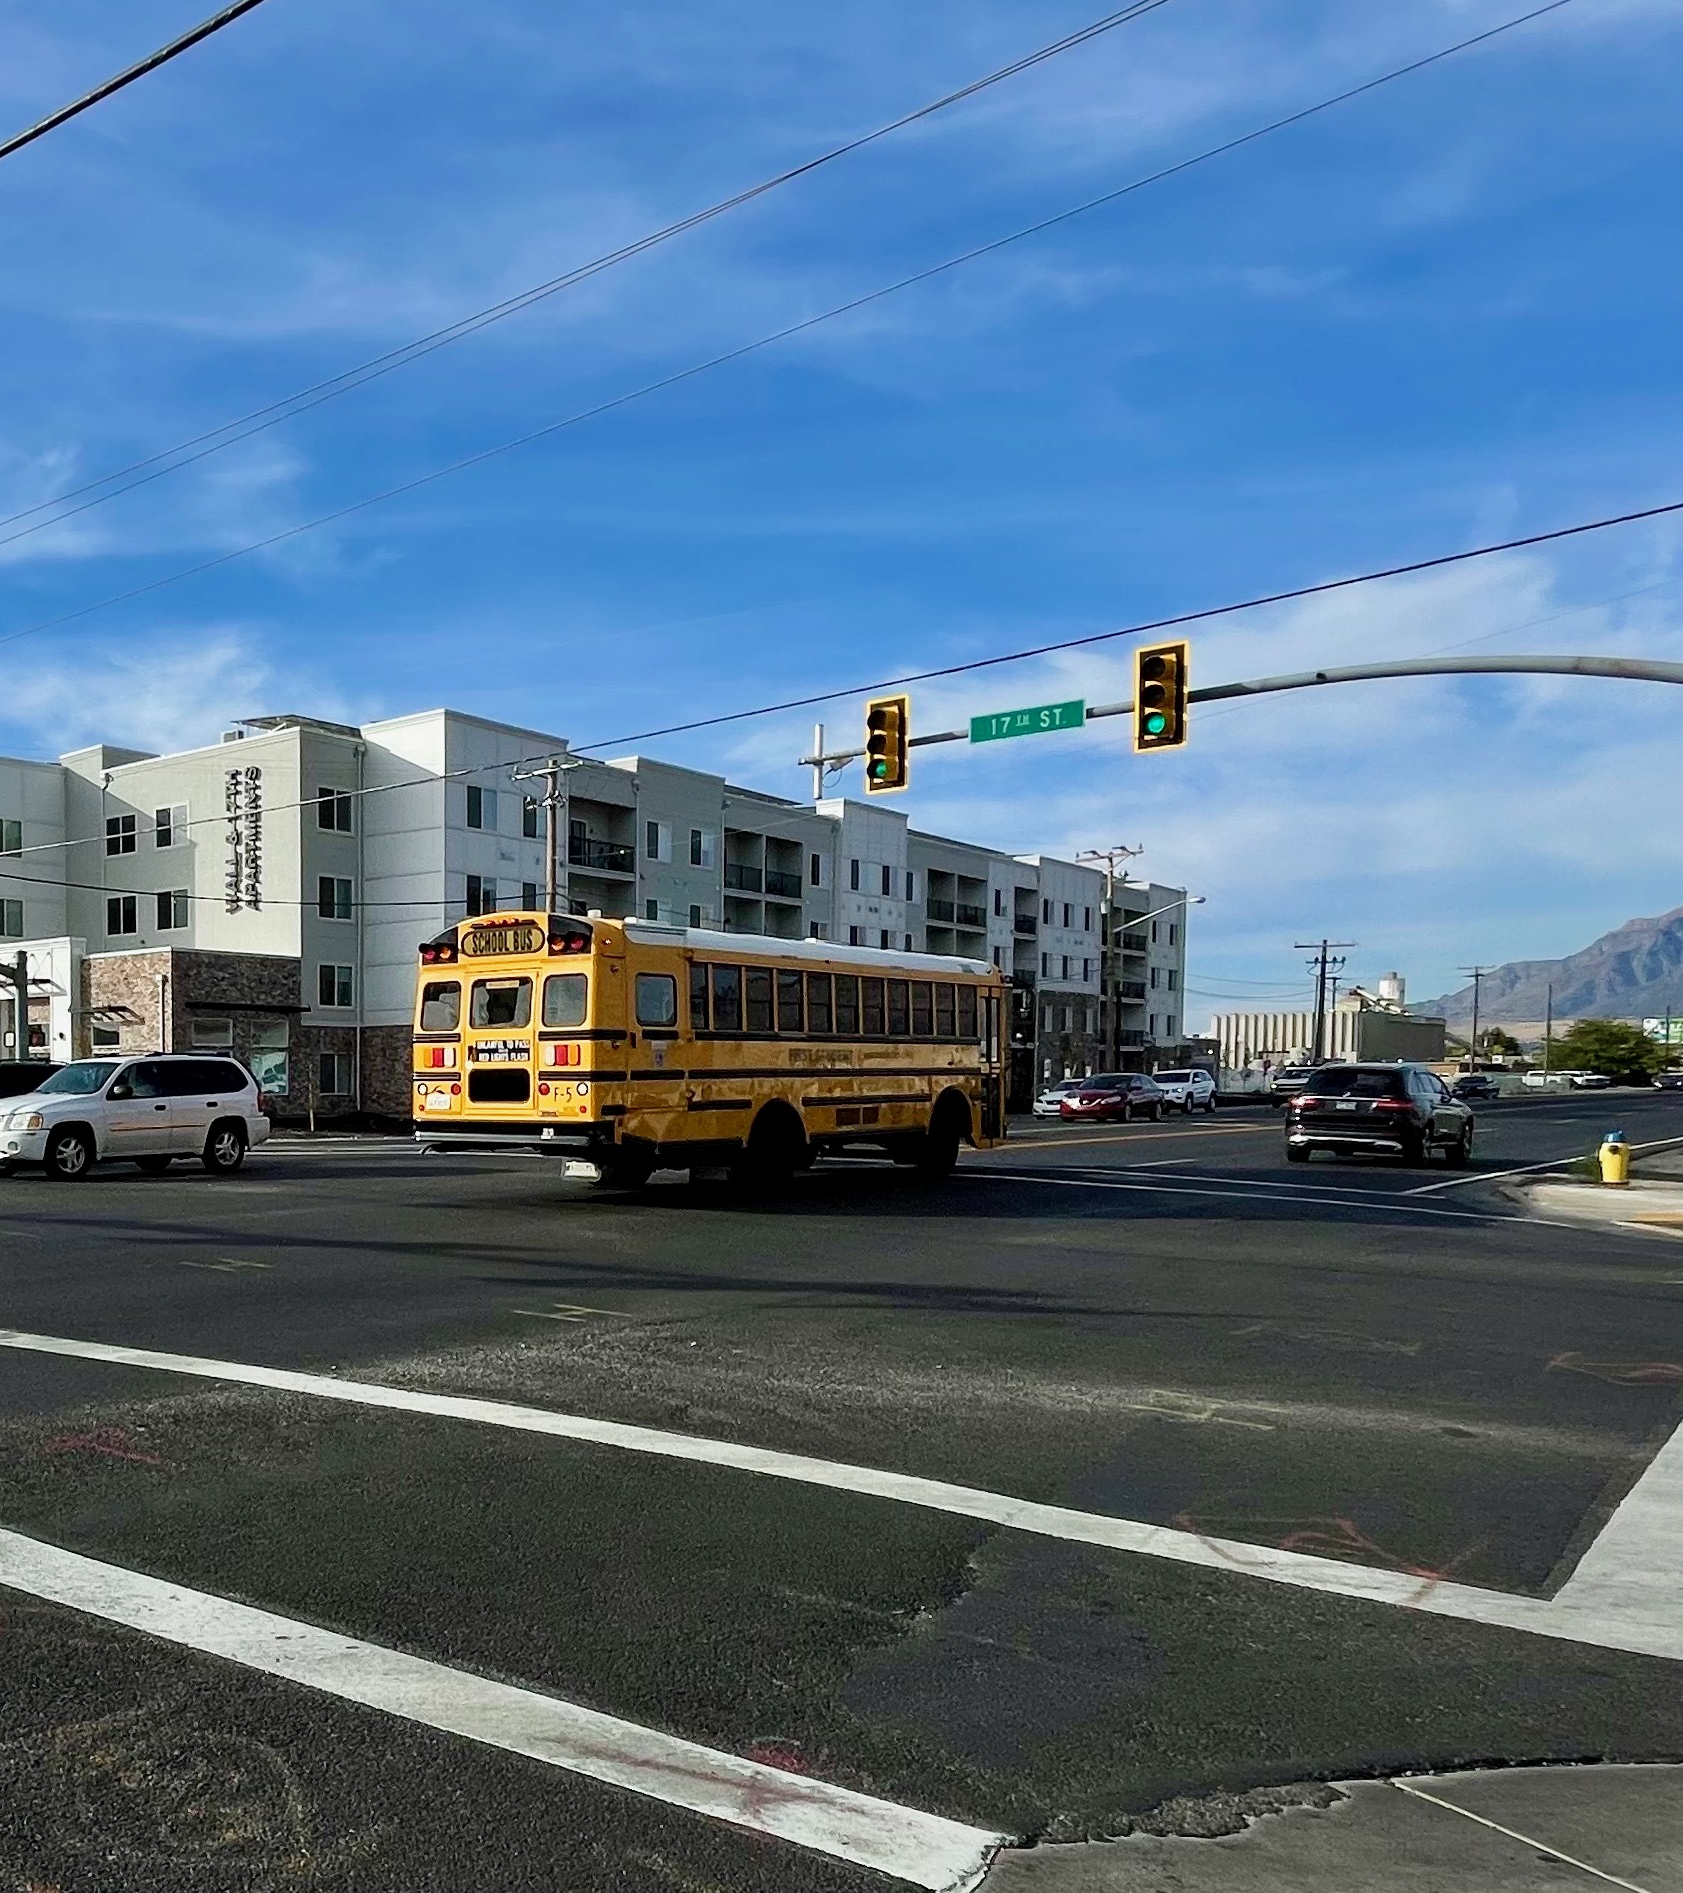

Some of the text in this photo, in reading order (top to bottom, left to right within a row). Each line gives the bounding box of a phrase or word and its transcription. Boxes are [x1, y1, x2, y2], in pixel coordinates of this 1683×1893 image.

[244, 766, 262, 912] APARTMENTS
[471, 929, 533, 954] SCHOOL BUS
[553, 1086, 573, 1104] F-5
